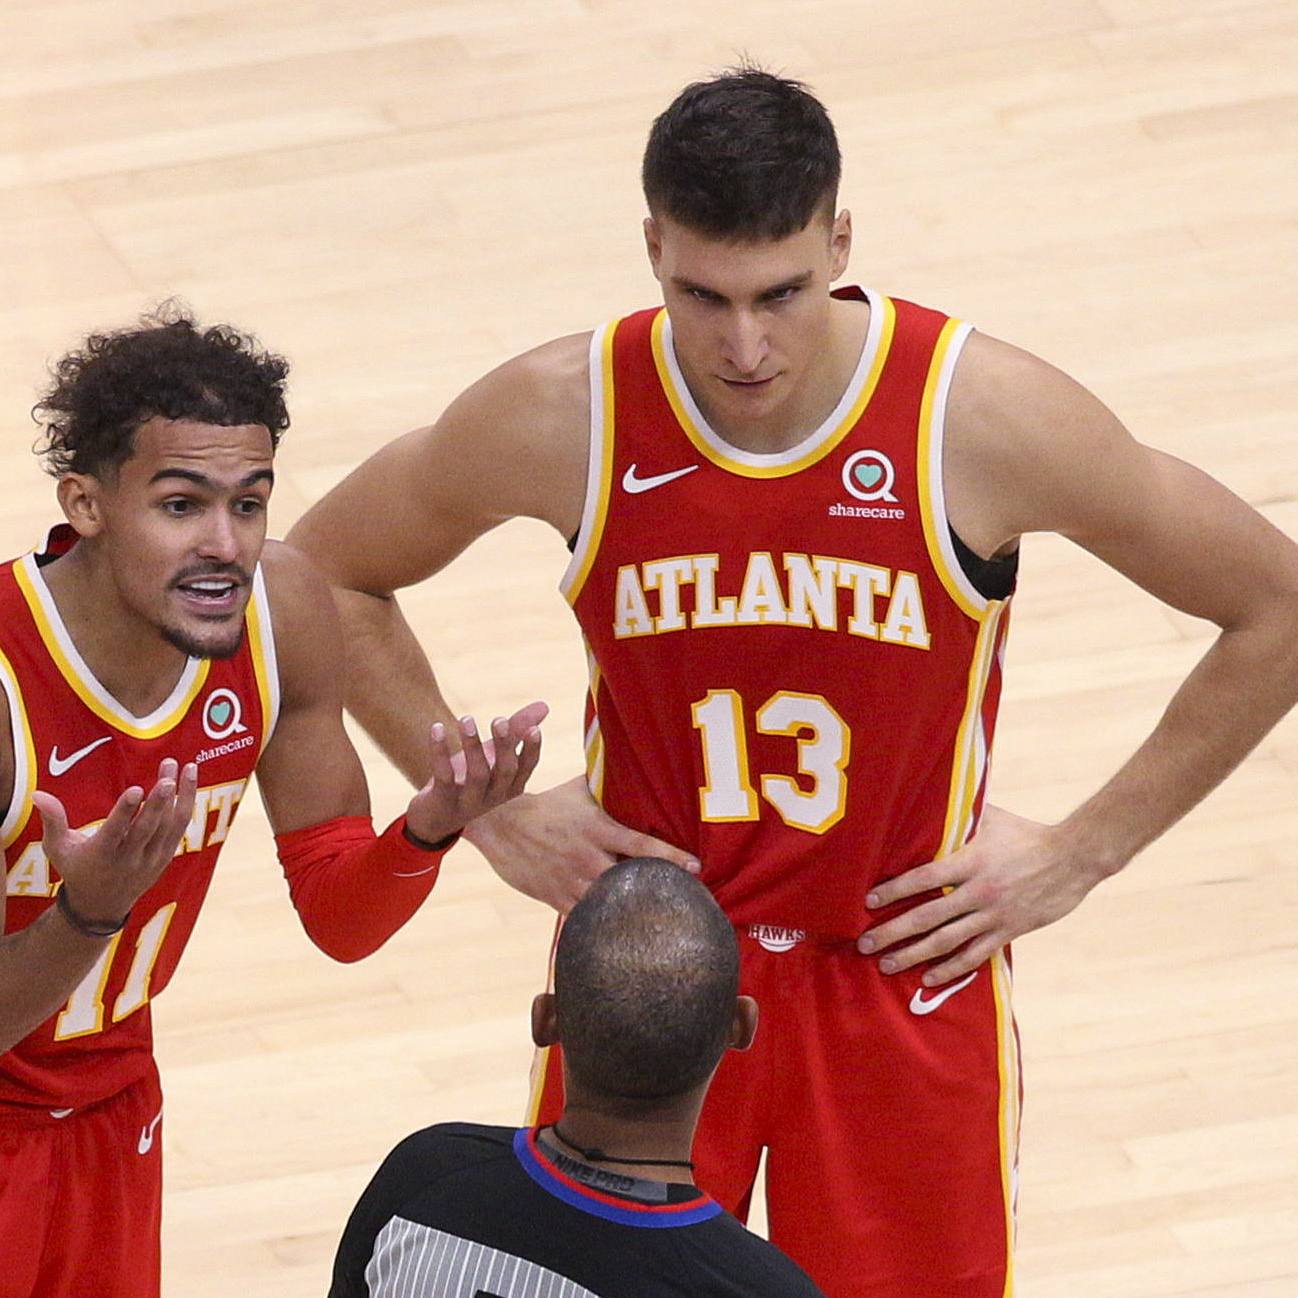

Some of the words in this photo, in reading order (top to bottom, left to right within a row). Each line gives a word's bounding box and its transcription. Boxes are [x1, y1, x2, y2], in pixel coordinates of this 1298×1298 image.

[828, 503, 905, 520] sharecare
[614, 551, 931, 650] ATLANTA
[195, 734, 255, 764] sharecare
[690, 688, 852, 835] 13
[748, 923, 806, 941] HAWKS
[54, 902, 178, 1042] 11
[553, 1154, 594, 1182] NIKE
[593, 1166, 636, 1192] PRO
